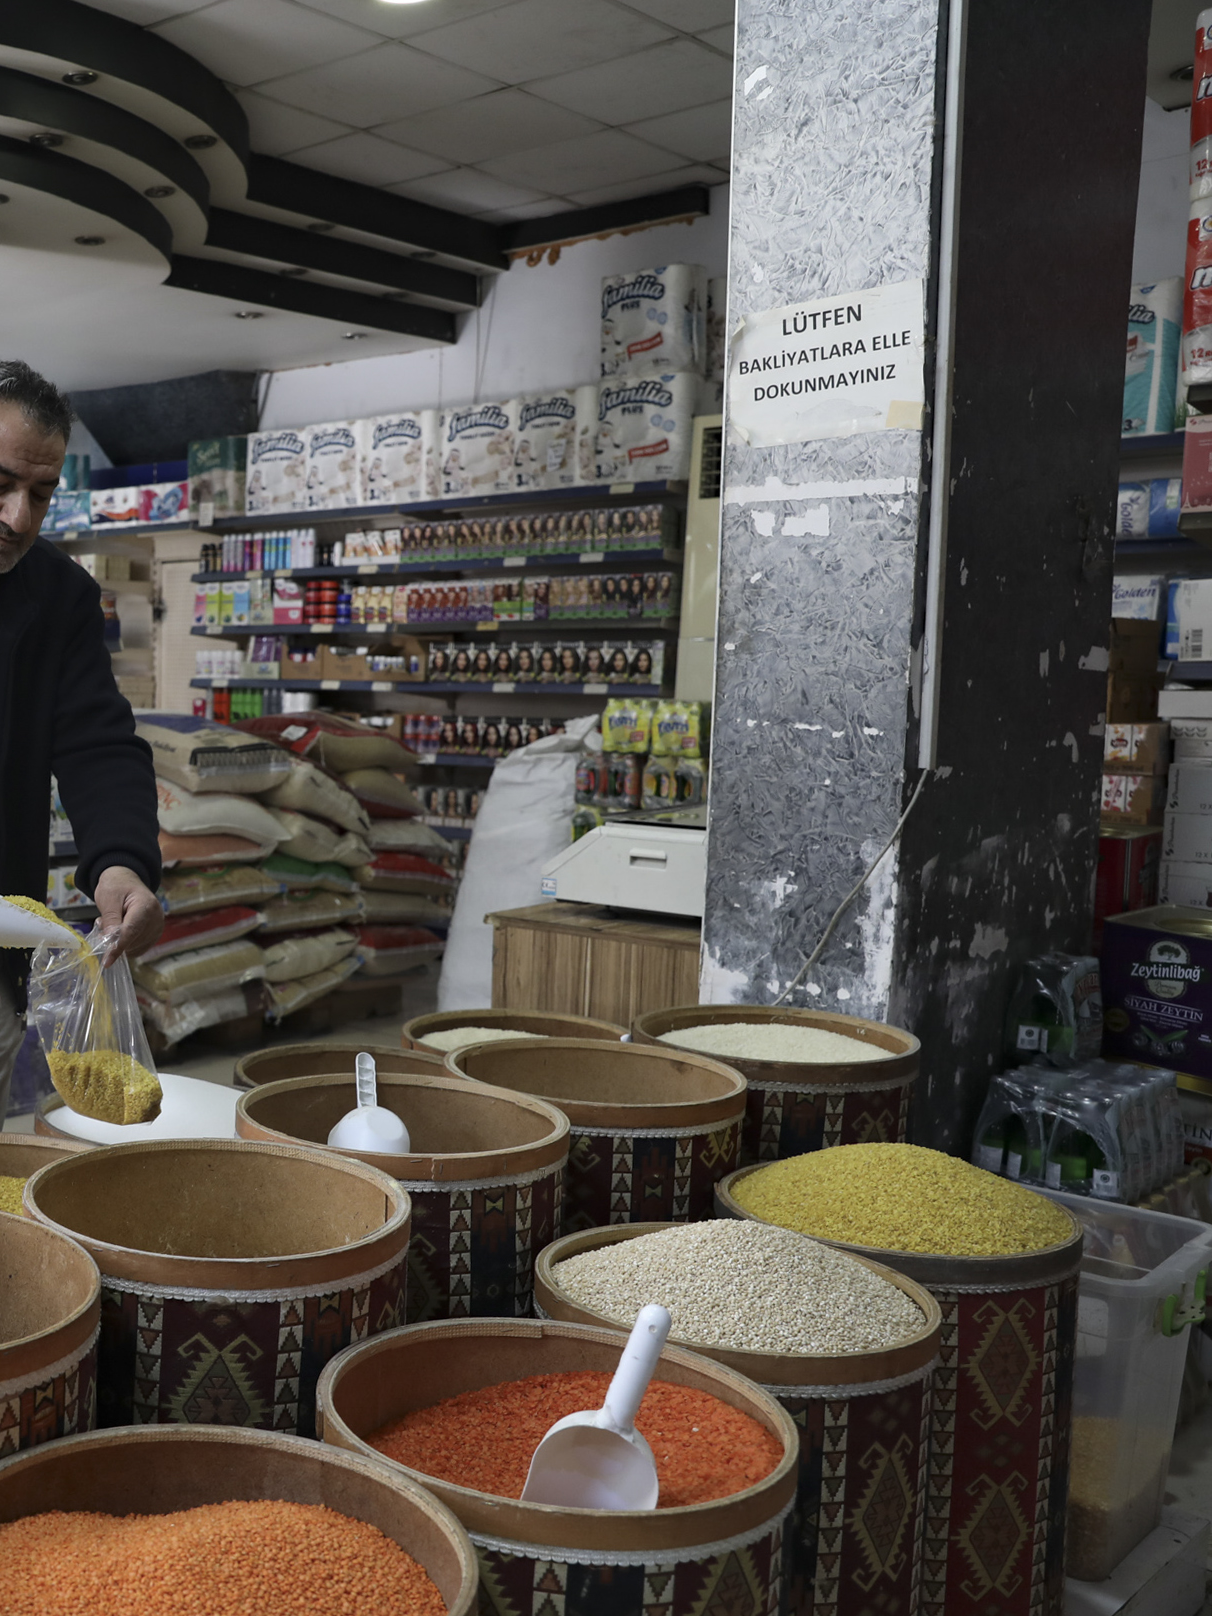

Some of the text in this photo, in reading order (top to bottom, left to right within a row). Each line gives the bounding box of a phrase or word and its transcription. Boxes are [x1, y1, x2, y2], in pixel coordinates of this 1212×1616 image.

[601, 275, 665, 319] familia
[782, 303, 863, 336] LÜTFEN
[739, 330, 912, 375] BAKLİYATLARA ELLE
[754, 364, 897, 401] DOKUNMAYINIZ
[518, 397, 576, 432] familia
[598, 381, 673, 421] familia
[372, 419, 422, 450] familia
[447, 405, 509, 442] familia
[252, 432, 305, 465] familia
[310, 428, 355, 459] familia
[1115, 587, 1157, 600] Golden
[1130, 962, 1201, 982] Zeytinlibağ
[1124, 997, 1157, 1012] SİYAH
[1160, 1004, 1204, 1021] ZEYTİN
